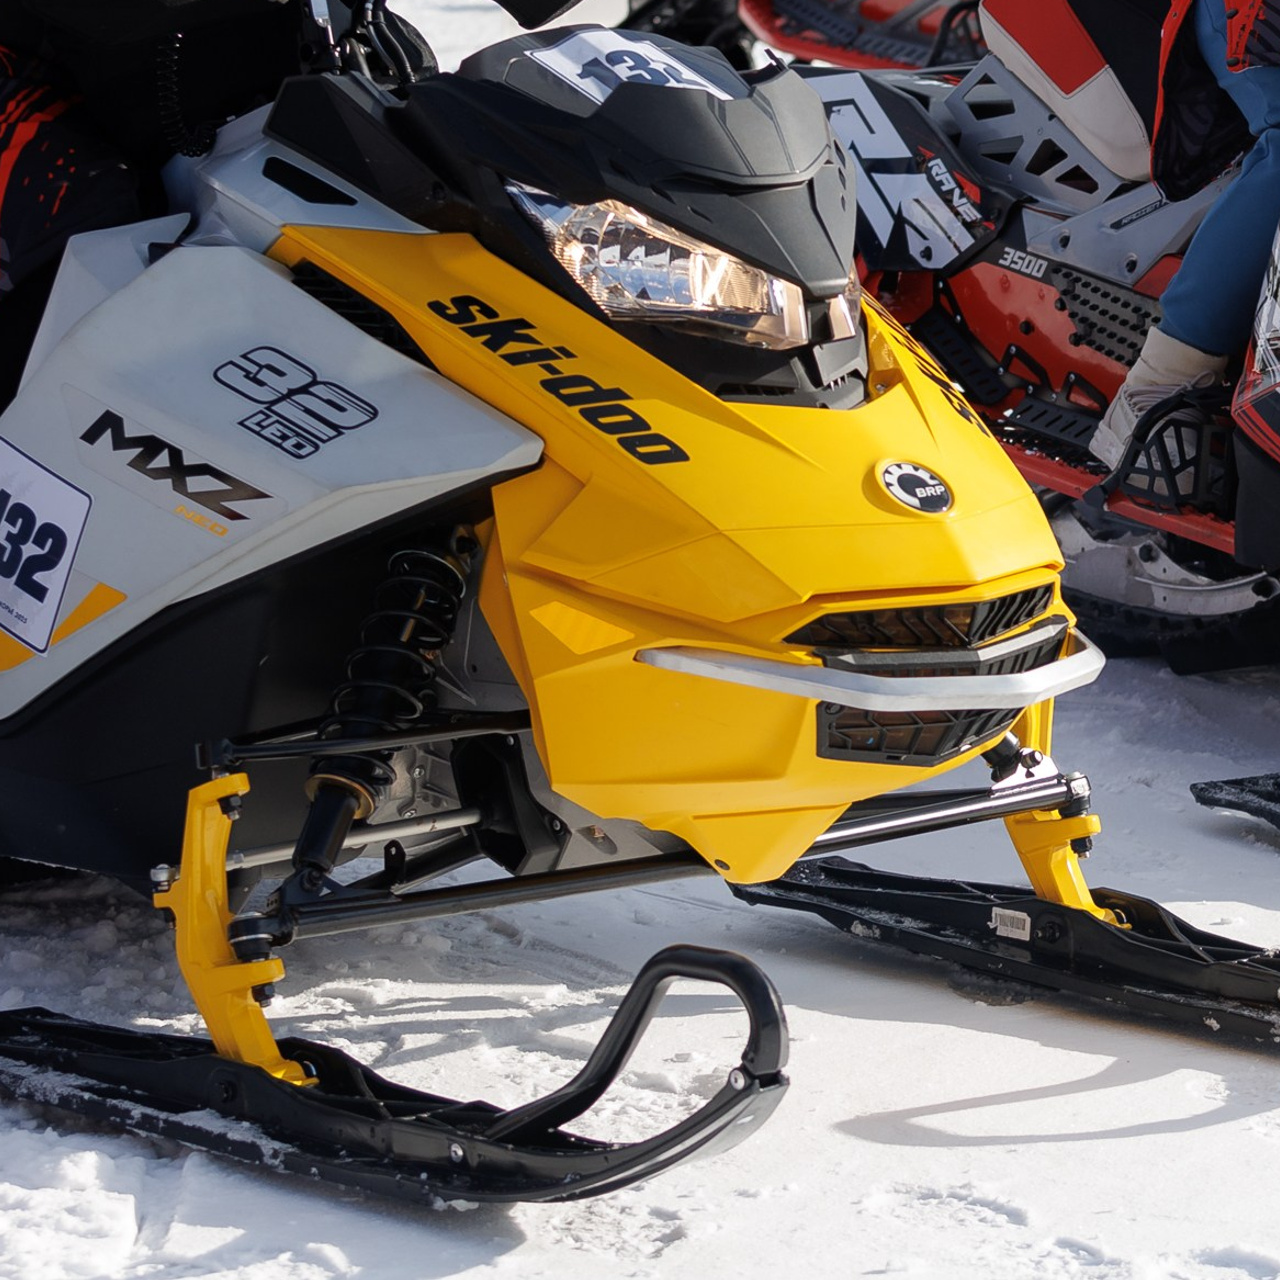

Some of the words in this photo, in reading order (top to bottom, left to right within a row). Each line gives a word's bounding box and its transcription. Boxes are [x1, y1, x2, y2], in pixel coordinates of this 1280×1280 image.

[927, 157, 983, 223] RAVE
[998, 246, 1049, 278] 3500
[212, 345, 380, 432] 32
[237, 408, 321, 460] LEO
[79, 408, 274, 521] MXZ
[915, 485, 946, 498] BRP
[0, 488, 68, 605] 32
[174, 503, 230, 538] NEO
